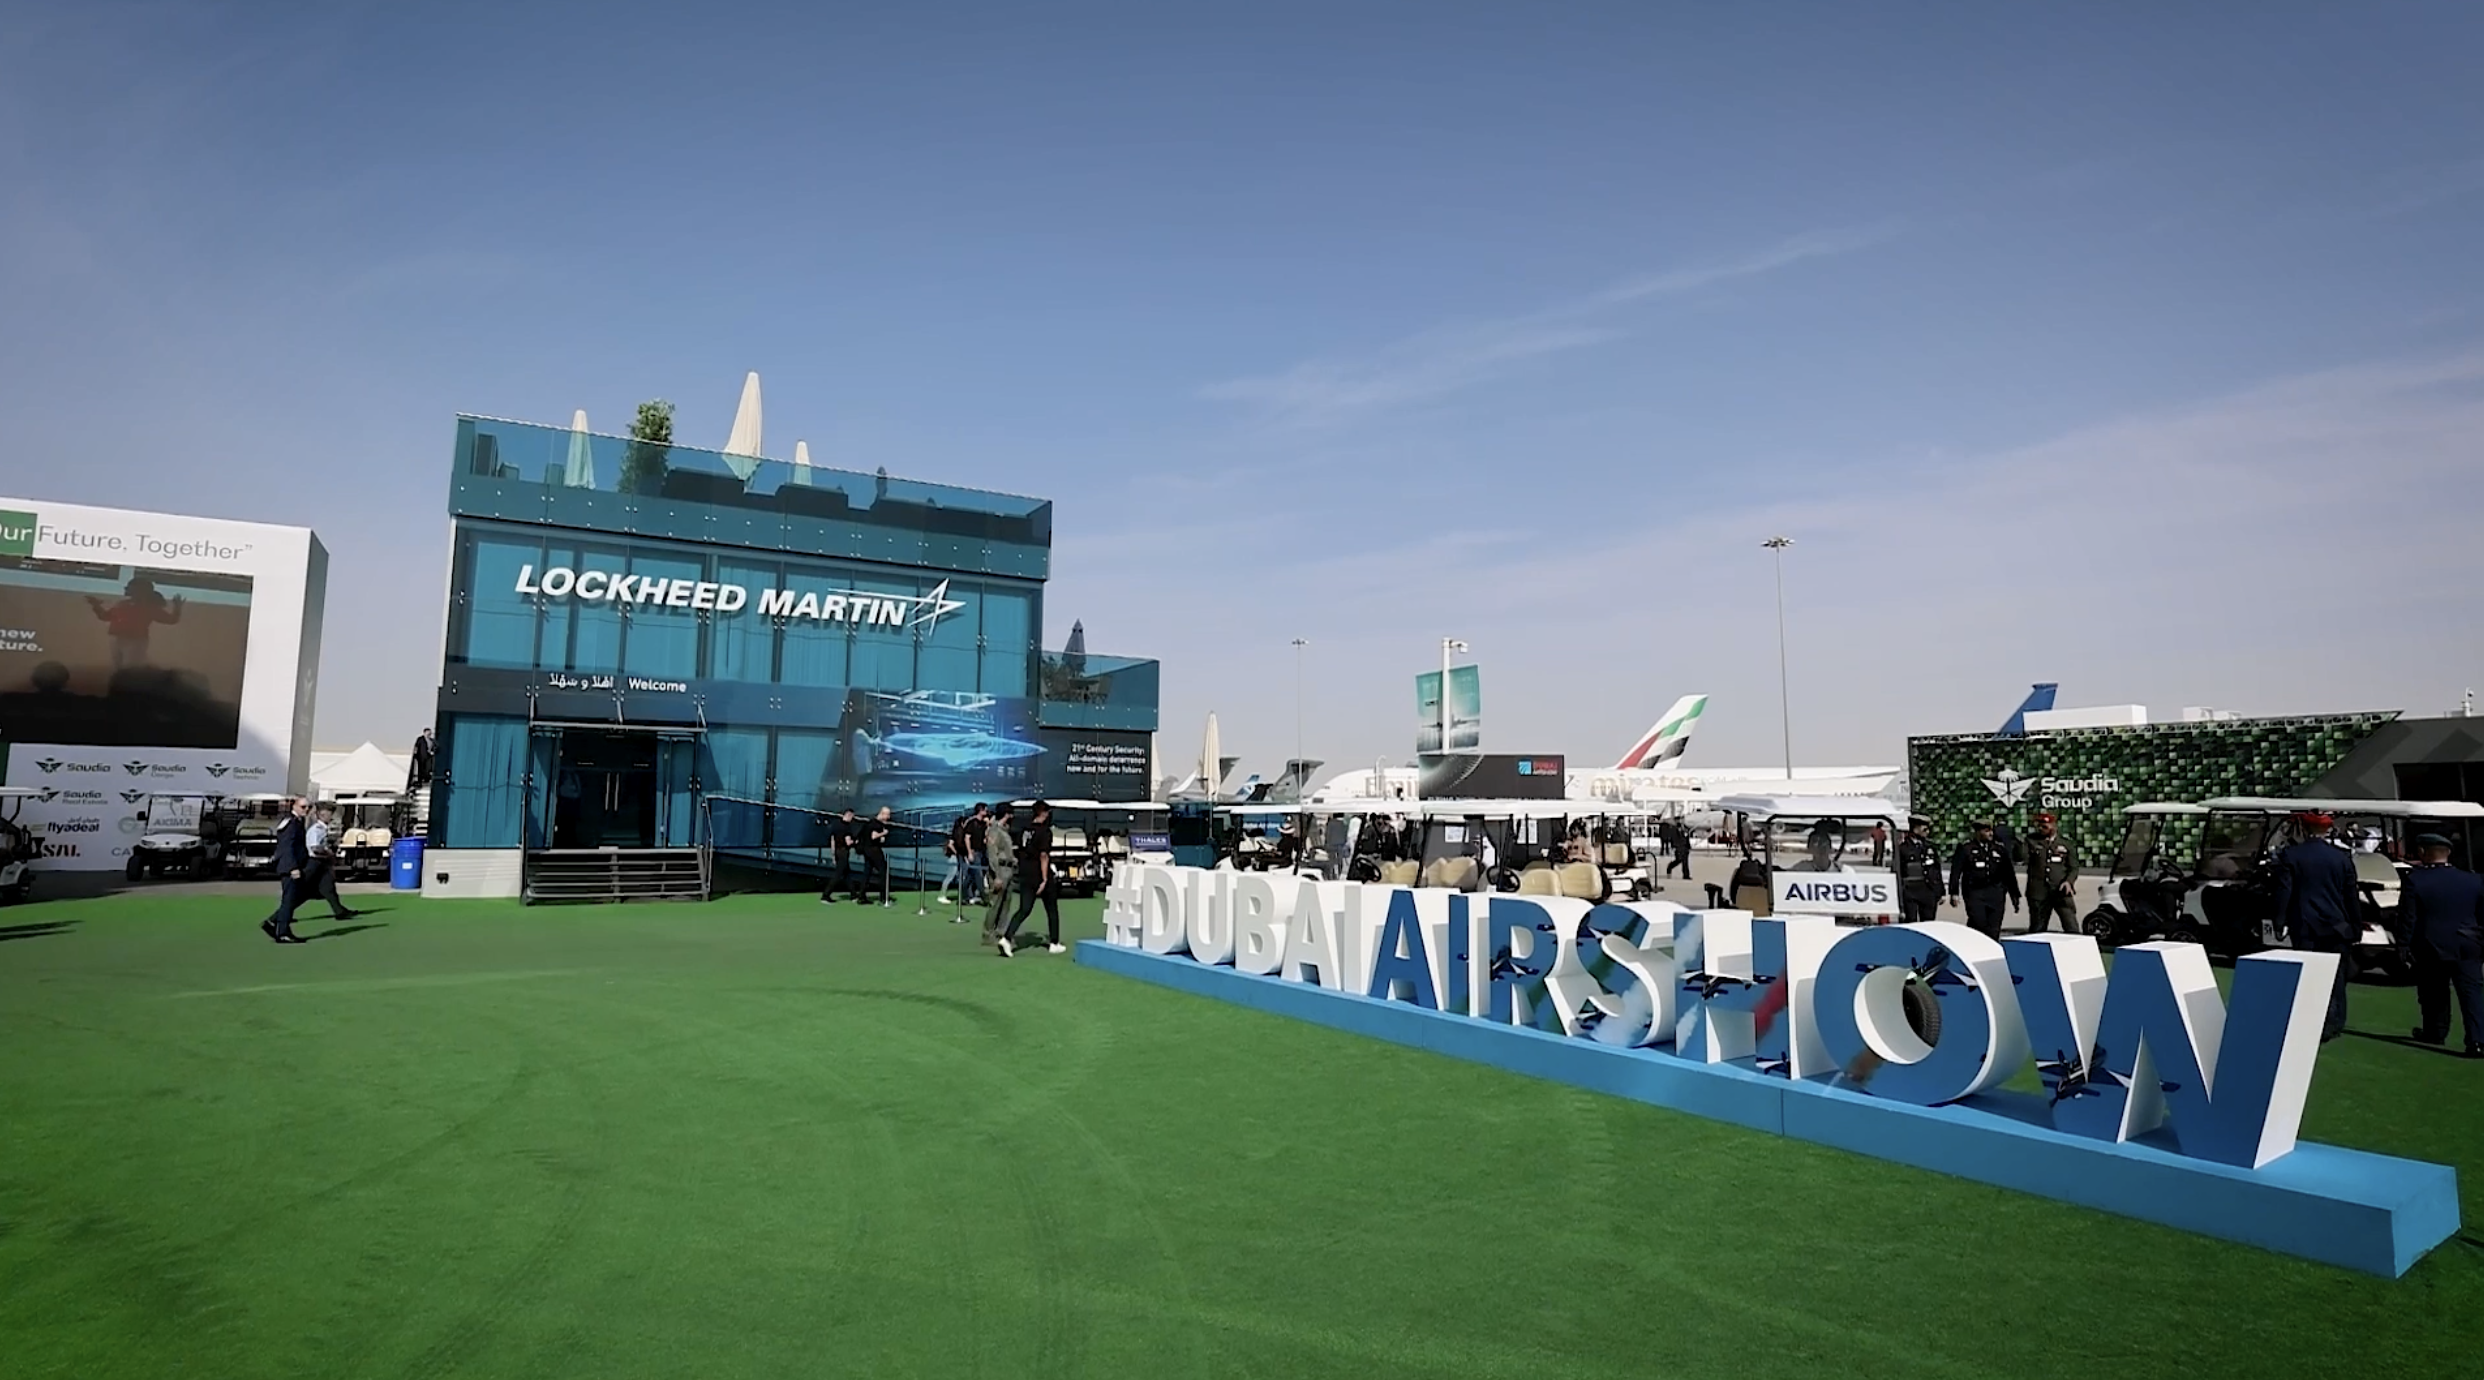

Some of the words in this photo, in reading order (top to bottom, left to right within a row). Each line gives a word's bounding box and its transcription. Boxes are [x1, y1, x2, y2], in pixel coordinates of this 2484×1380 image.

[515, 565, 746, 611] LOCKHEED
[757, 589, 908, 627] MARTIN
[628, 677, 687, 692] Welcome
[1086, 744, 1114, 755] Century
[67, 762, 111, 773] Saudia
[151, 764, 187, 773] Saudia
[233, 766, 266, 775] Saudia
[1083, 765, 1096, 773] and
[1109, 765, 1120, 773] the
[2040, 774, 2119, 793] Saudia
[2042, 794, 2093, 813] Group
[47, 821, 100, 835] flyadeal
[1785, 883, 1888, 903] AIRBUS
